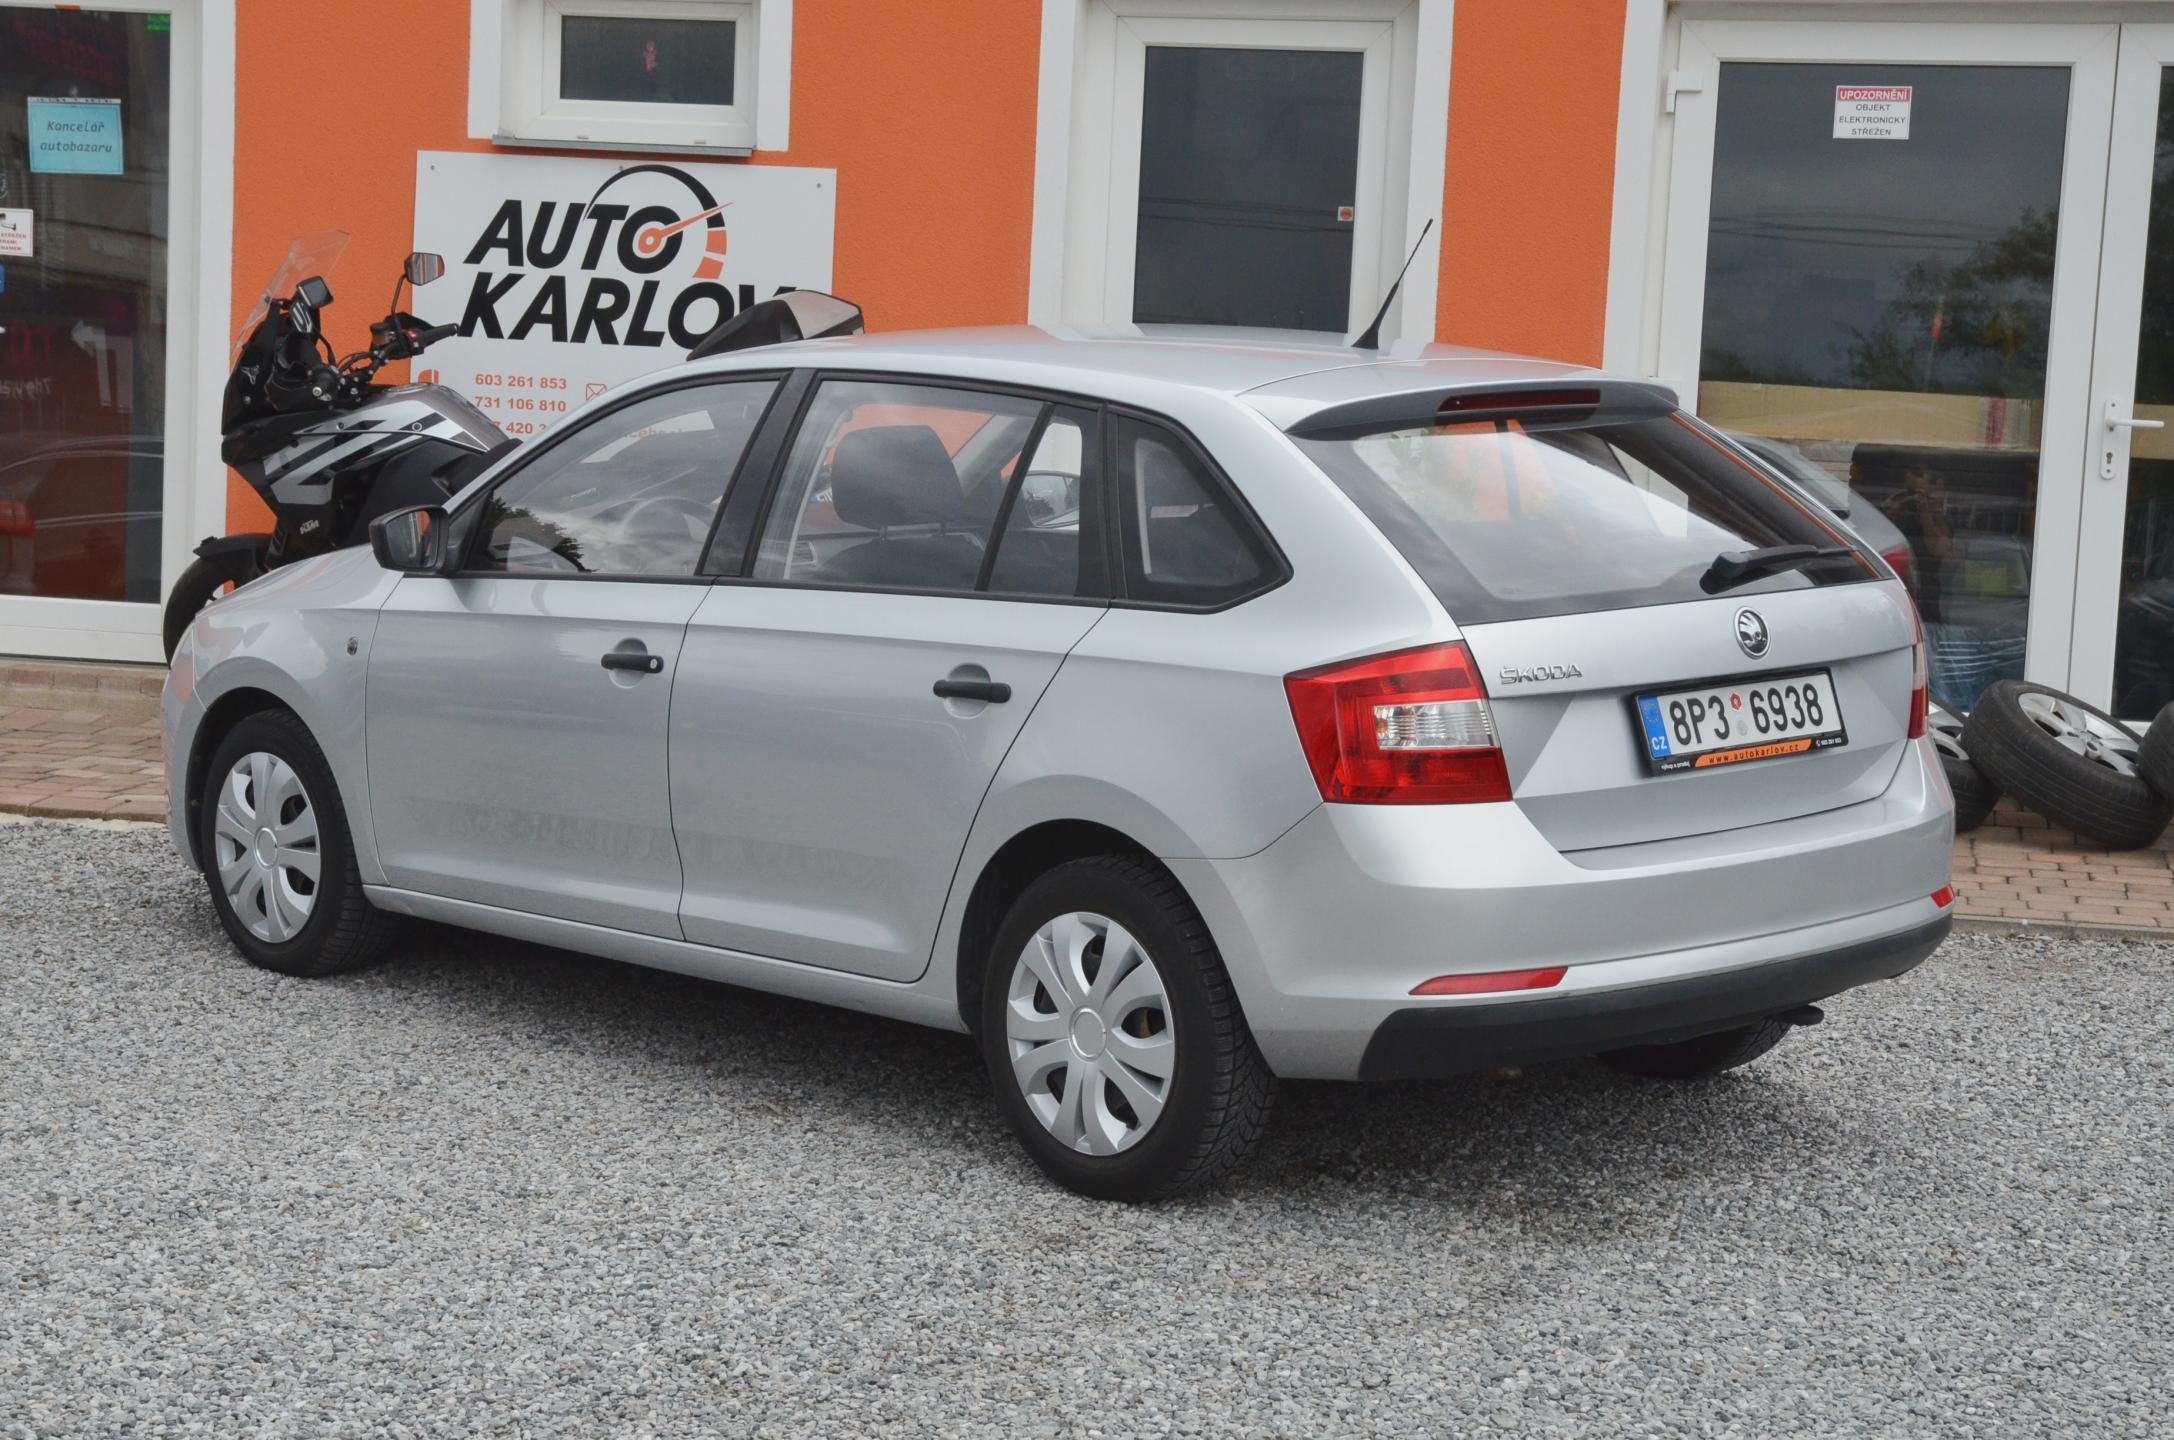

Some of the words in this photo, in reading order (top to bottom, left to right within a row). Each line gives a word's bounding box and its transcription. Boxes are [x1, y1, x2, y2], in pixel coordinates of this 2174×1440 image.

[1840, 88, 1908, 100] UPOZORNĚNÍ
[1855, 103, 1891, 112] OBJEKT
[47, 120, 105, 133] Kancelář
[1839, 115, 1906, 124] ELEKTRONICKY
[40, 141, 113, 153] autobazaru
[463, 199, 684, 274] AUTO
[474, 373, 503, 386] 603
[507, 375, 534, 388] 261
[539, 377, 568, 390] 853
[474, 396, 501, 409] 731
[507, 397, 534, 410] 106
[539, 399, 567, 412] 810
[505, 421, 534, 434] 420
[1669, 695, 1731, 746] 8P3
[1749, 683, 1823, 734] 6938
[1651, 736, 1668, 751] CZ
[1708, 743, 1800, 764] www.autokarlov.cz
